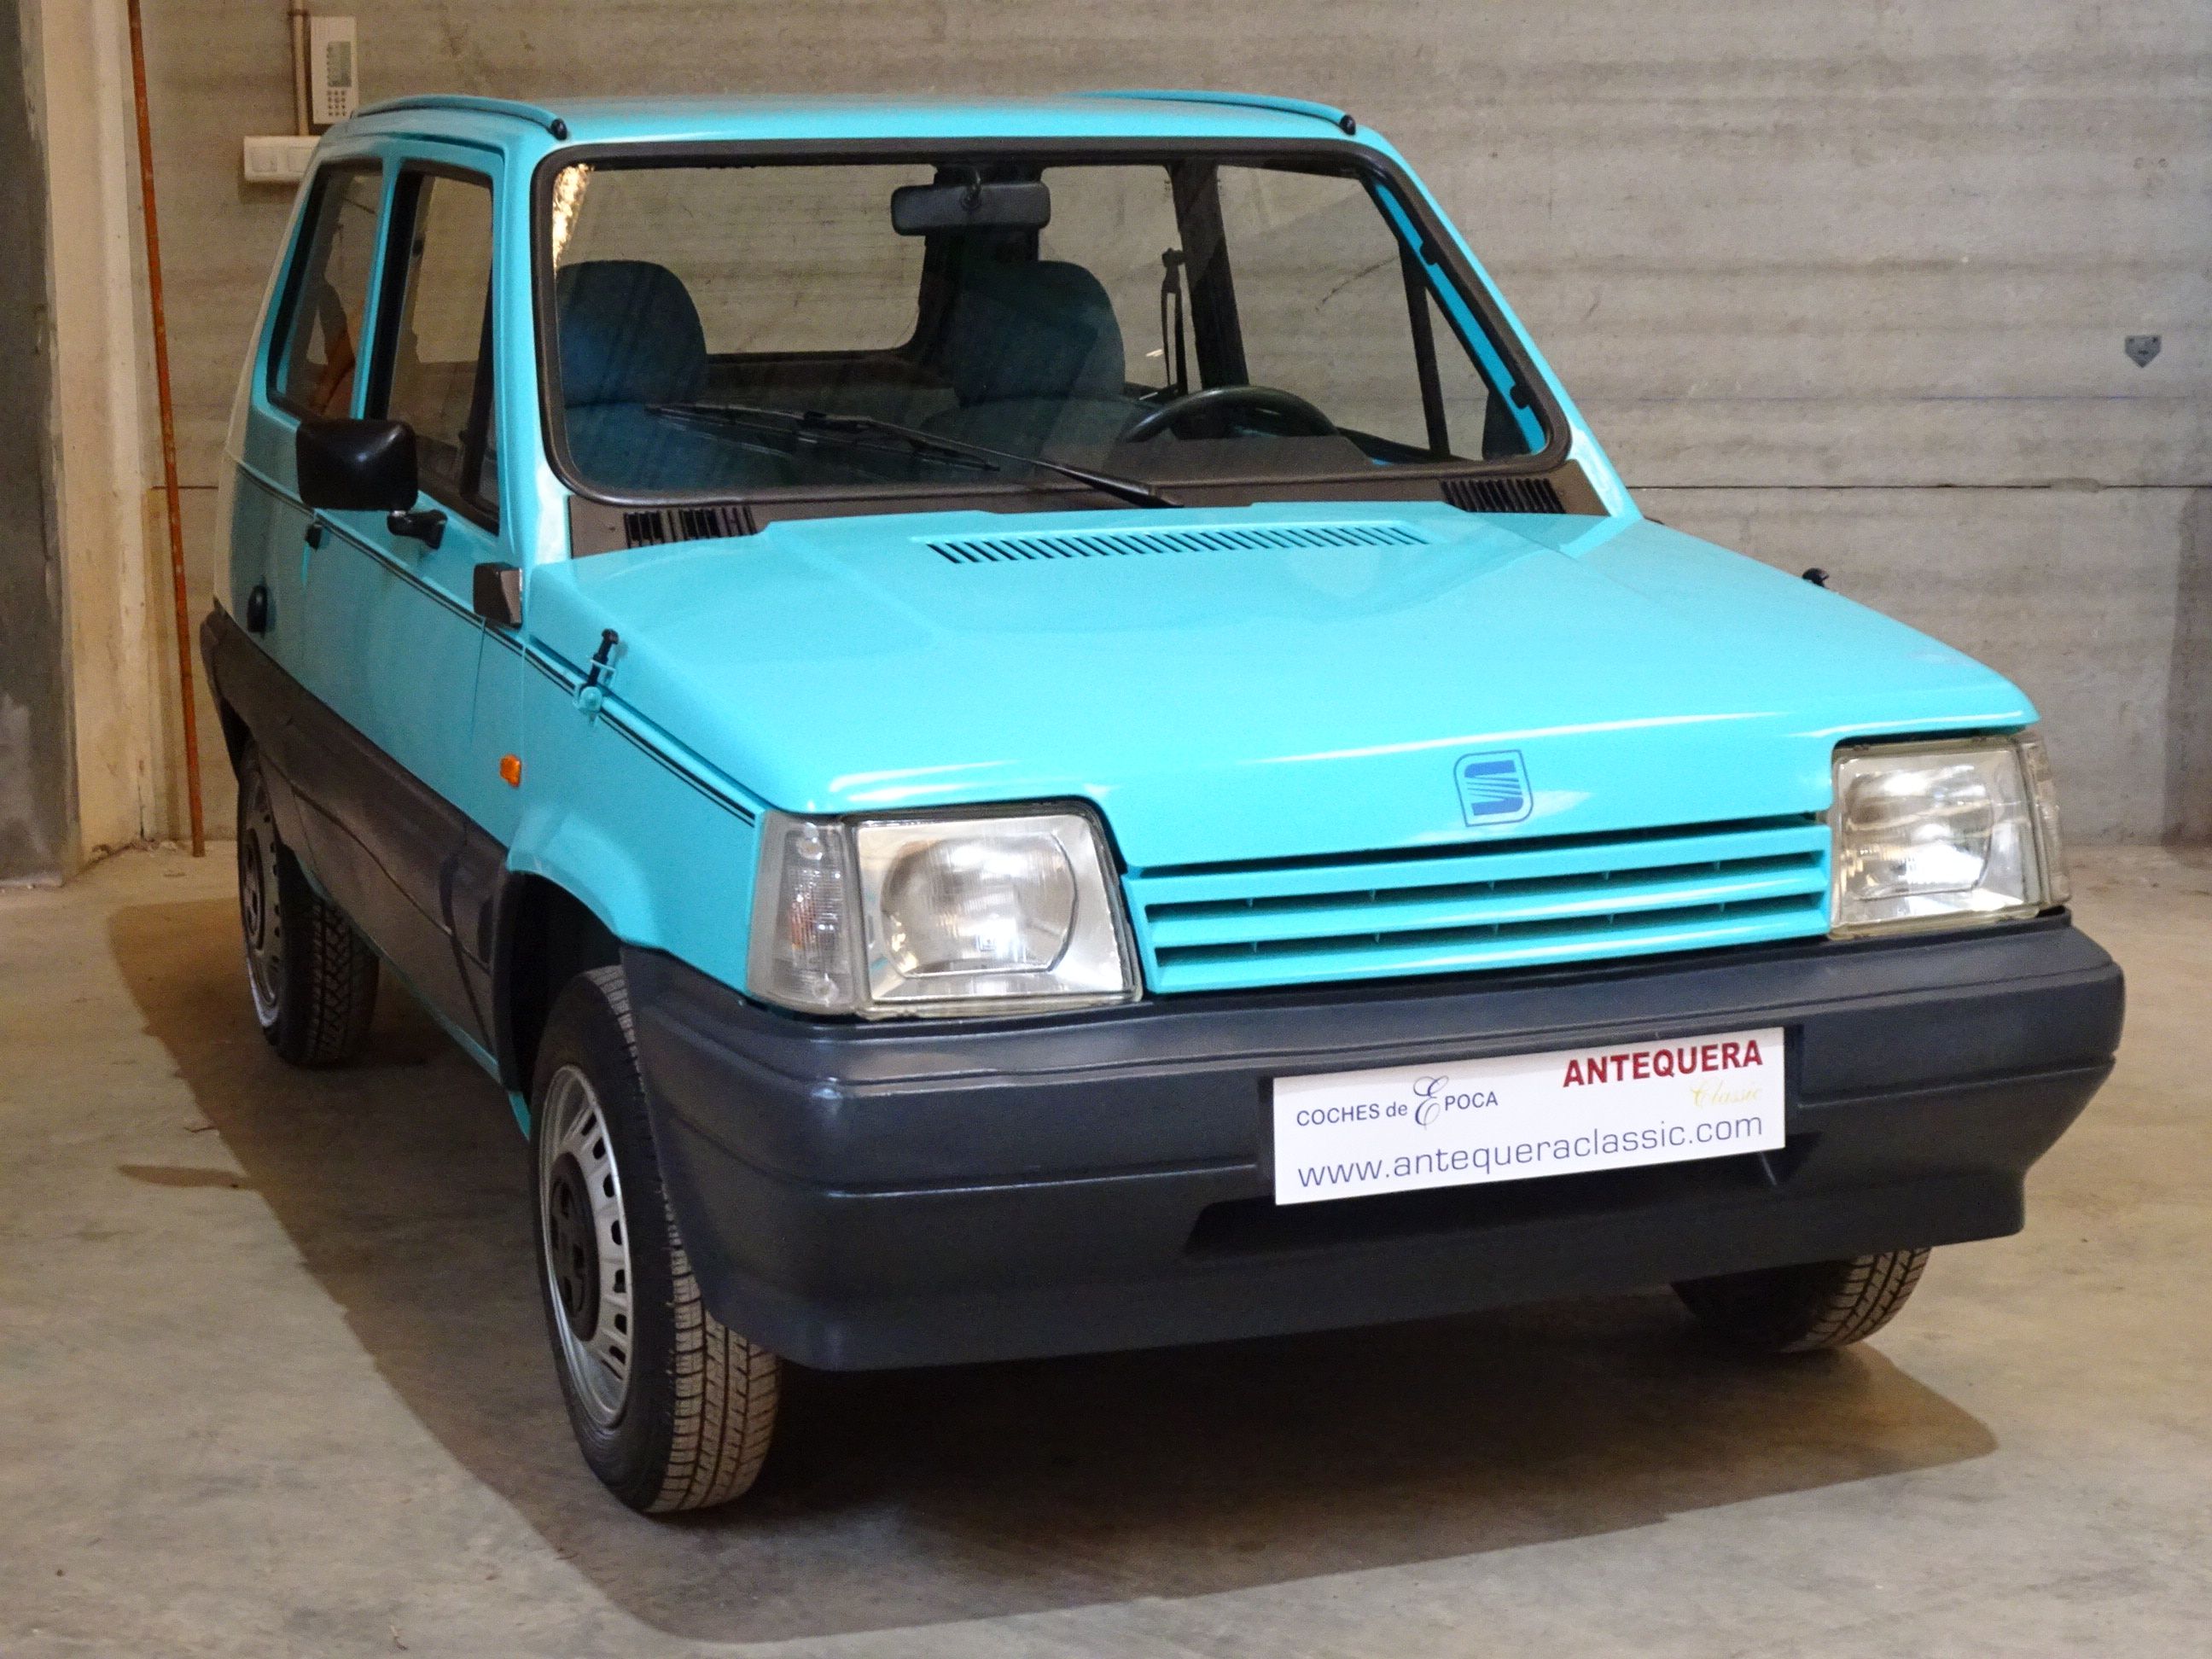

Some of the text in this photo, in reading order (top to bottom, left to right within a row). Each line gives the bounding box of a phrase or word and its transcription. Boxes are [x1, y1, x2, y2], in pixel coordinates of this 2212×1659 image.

[1563, 1039, 1763, 1088] ANTEQUERA
[1296, 1103, 1380, 1126] COCHES
[1385, 1101, 1408, 1118] de
[1297, 1116, 1762, 1188] www.antequeraclassic.com
